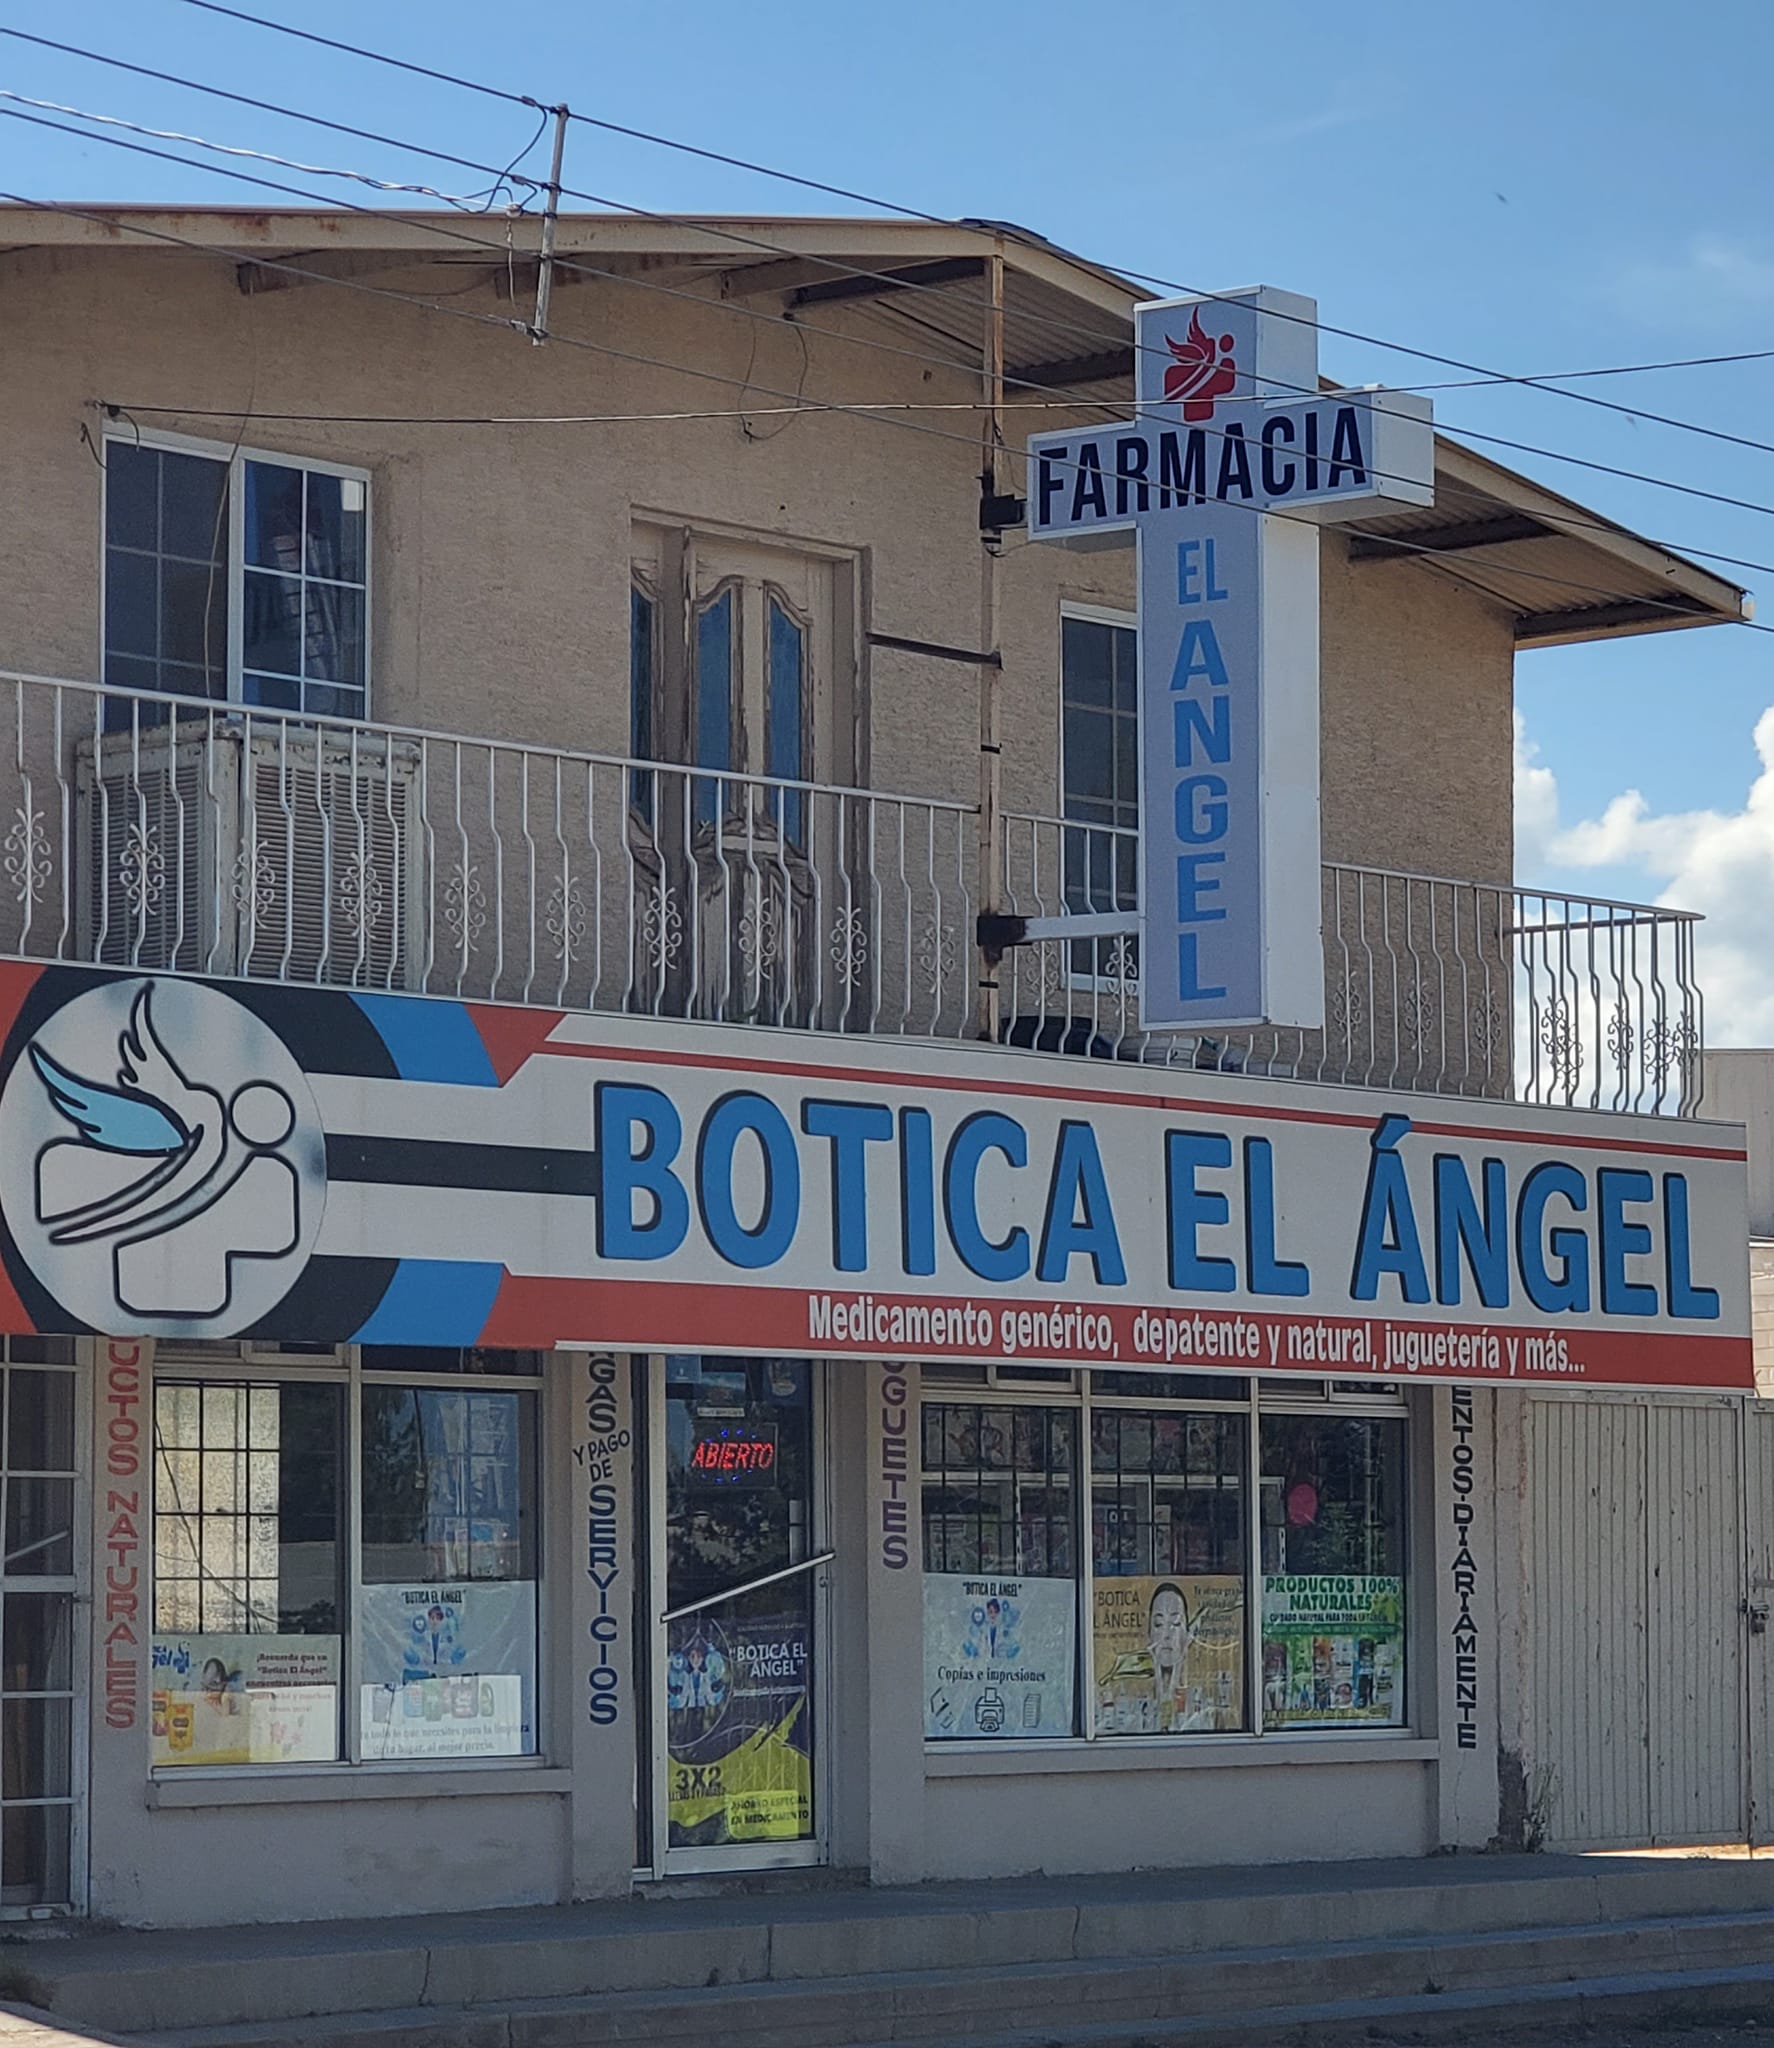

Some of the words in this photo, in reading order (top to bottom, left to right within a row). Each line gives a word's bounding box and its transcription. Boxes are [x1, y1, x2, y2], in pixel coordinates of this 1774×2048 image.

[1038, 407, 1367, 526] FARMACIA
[1175, 538, 1229, 605] EL
[1170, 619, 1232, 1000] ANGEL
[594, 1080, 1127, 1286] BOTICA
[1165, 1128, 1309, 1297] EL
[1350, 1113, 1720, 1319] ÁNGEL
[808, 1295, 994, 1347] Medicamento
[1001, 1304, 1119, 1358] genérico,
[1268, 1325, 1281, 1366] y
[1287, 1320, 1378, 1370] natural,
[1383, 1322, 1500, 1373] juguetería
[1504, 1337, 1518, 1376] y
[1525, 1330, 1586, 1374] más...
[107, 1337, 140, 1476] UCTOS
[584, 1352, 618, 1434] GAS
[572, 1445, 585, 1466] Y
[588, 1430, 631, 1461] PAGO
[589, 1458, 613, 1482] DE
[691, 1441, 774, 1470] ABIERTO
[105, 1491, 139, 1730] NATURALES
[587, 1484, 620, 1725] SERVICIOS
[1265, 1576, 1355, 1594] PRODUCTOS
[1361, 1577, 1399, 1594] 100%
[1289, 1594, 1373, 1612] NATURALES
[792, 1642, 808, 1659] EL
[986, 1667, 1046, 1684] impresiones
[675, 1766, 723, 1791] 3X2
